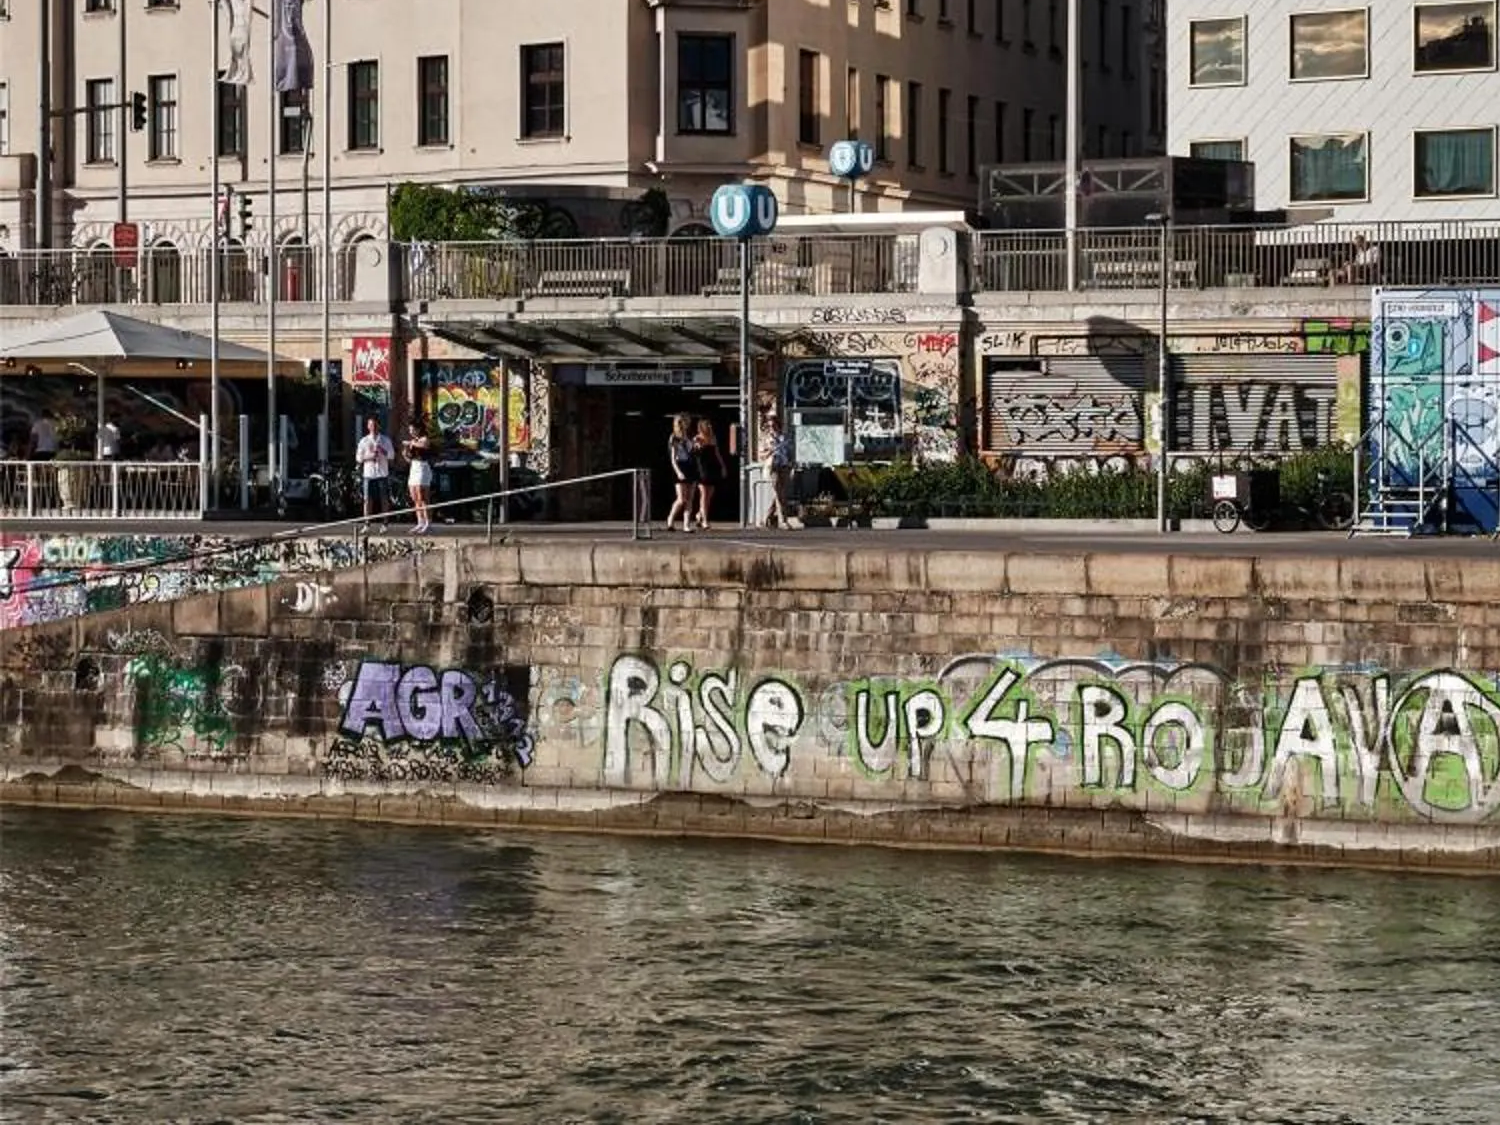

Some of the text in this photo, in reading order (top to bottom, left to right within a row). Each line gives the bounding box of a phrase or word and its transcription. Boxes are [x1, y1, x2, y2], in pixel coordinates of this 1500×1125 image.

[859, 148, 873, 171] U
[717, 194, 744, 229] U
[757, 195, 774, 229] U
[339, 661, 484, 741] AGR
[603, 652, 805, 789] Rise
[965, 666, 1055, 801] 4
